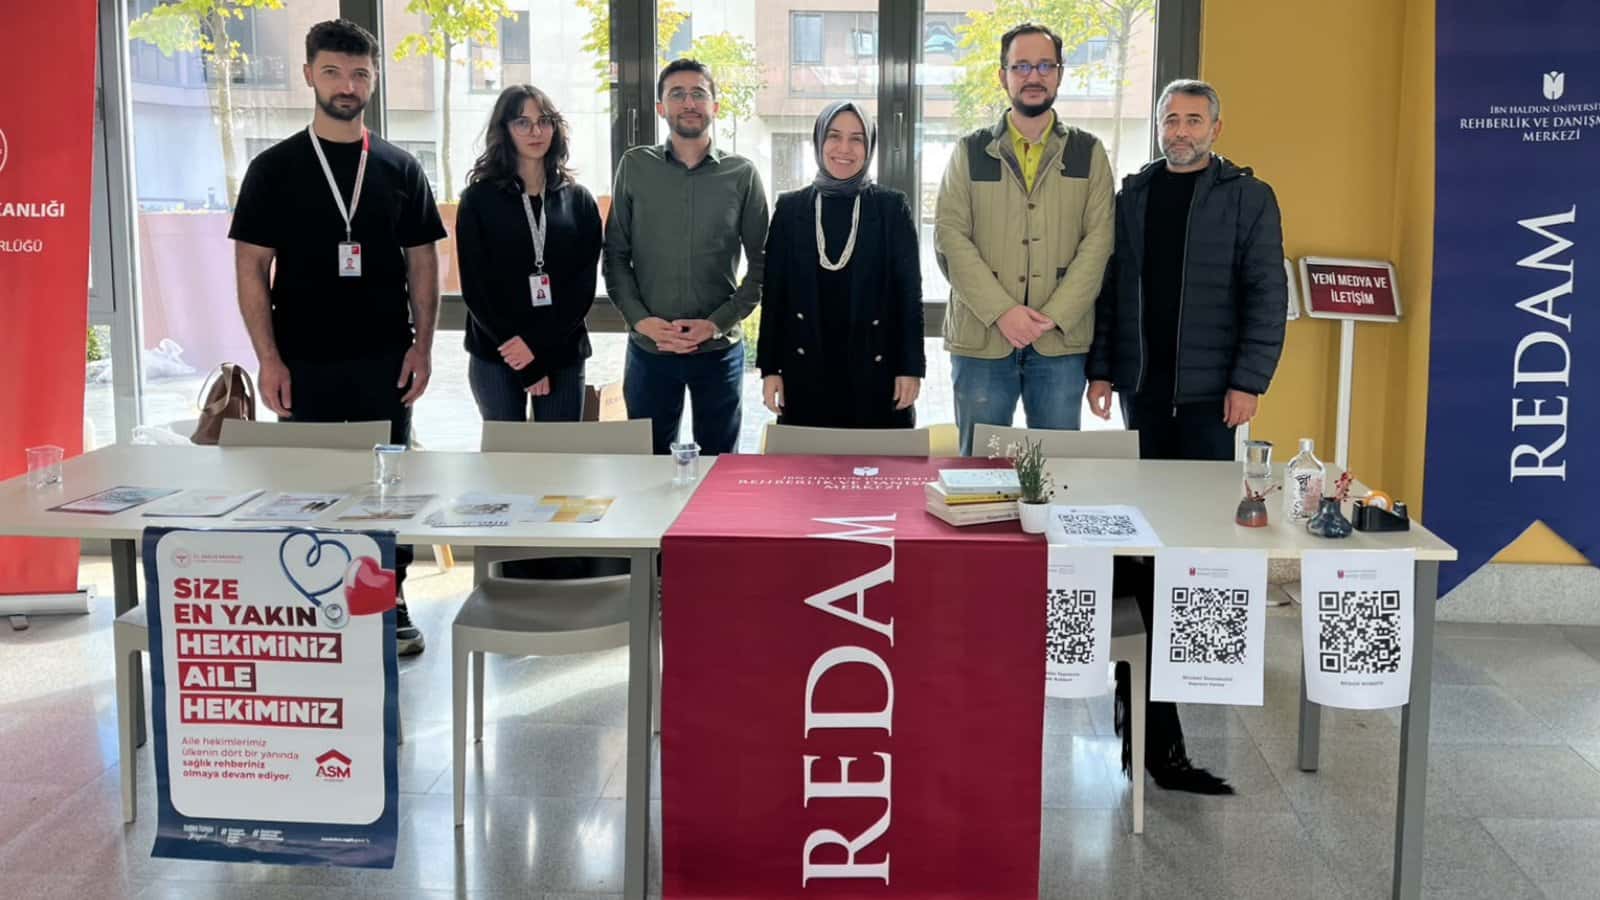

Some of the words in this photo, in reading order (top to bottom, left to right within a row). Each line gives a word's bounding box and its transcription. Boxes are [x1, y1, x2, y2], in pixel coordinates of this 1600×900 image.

[1509, 105, 1550, 114] HALDUN
[1460, 117, 1530, 129] REHBERLİK
[1533, 117, 1551, 128] VE
[1522, 128, 1580, 142] MERKEZİ
[0, 200, 65, 217] ANLIĞI
[1311, 271, 1336, 286] YENİ
[1337, 273, 1372, 288] MEDYA
[1373, 277, 1388, 289] VE
[1330, 288, 1375, 306] İLETİŞİM
[1510, 203, 1576, 483] REDAM
[174, 603, 213, 624] EN
[220, 604, 317, 627] YAKIN
[802, 512, 896, 888] REDAM
[182, 737, 200, 745] Aile
[203, 737, 267, 747] hekimlerimiz
[220, 748, 243, 757] dört
[245, 749, 258, 758] bir
[260, 751, 300, 761] yanında
[183, 759, 211, 769] sağlık
[214, 759, 266, 769] rehberiniz
[183, 769, 219, 780] olmaya
[221, 769, 256, 779] devam
[315, 765, 351, 778] ASM
